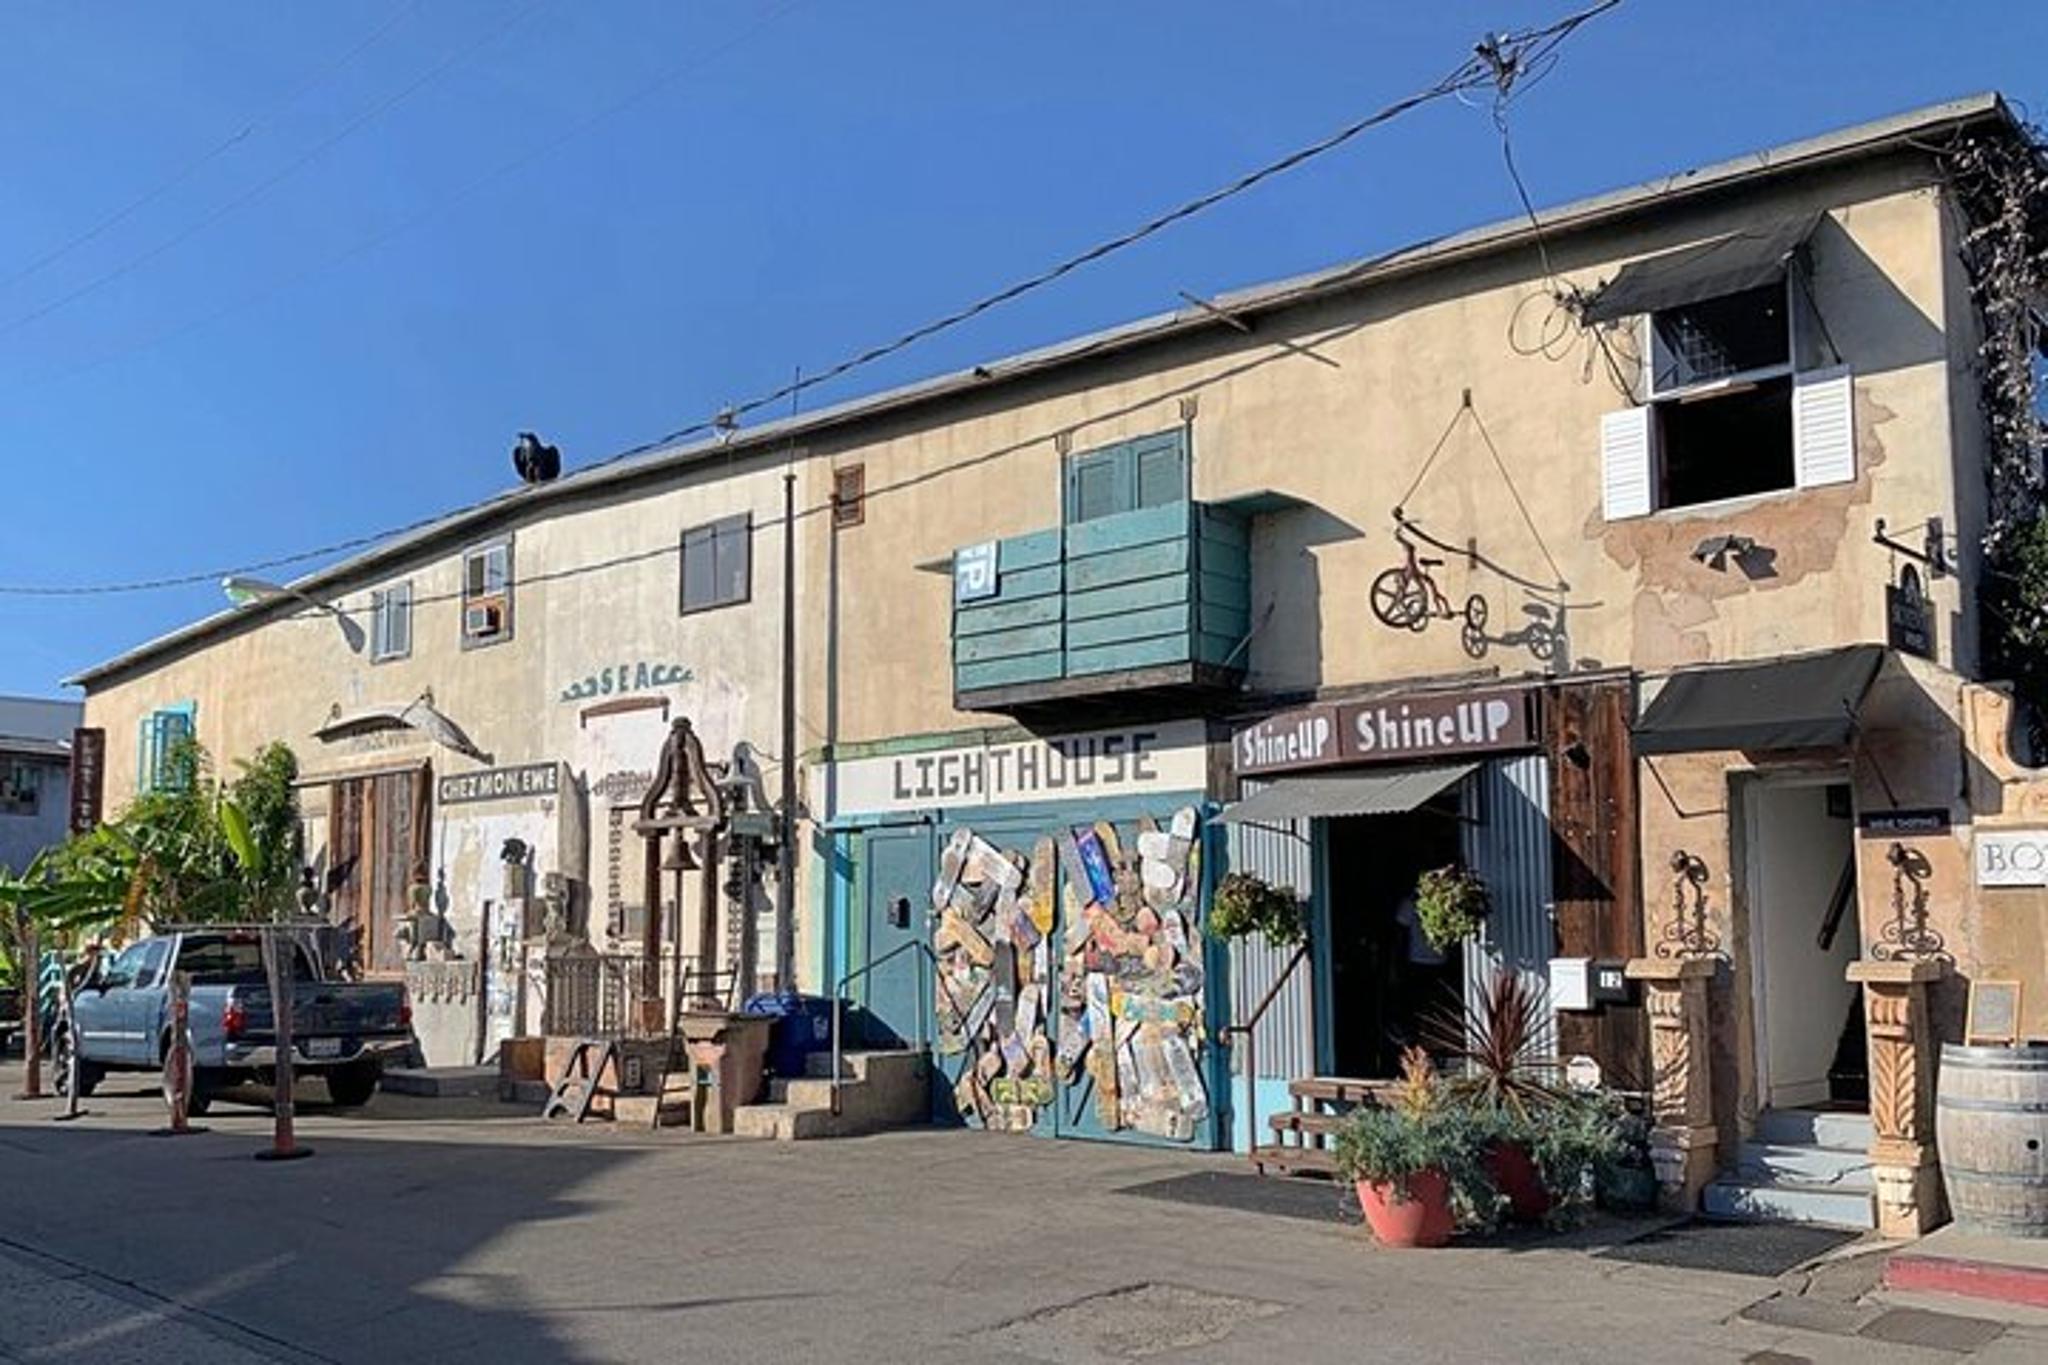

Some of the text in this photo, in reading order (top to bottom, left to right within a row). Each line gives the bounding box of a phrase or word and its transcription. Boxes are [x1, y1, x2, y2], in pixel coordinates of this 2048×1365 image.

[1243, 717, 1330, 767] ShineUP
[1357, 700, 1511, 752] ShineUP
[480, 772, 519, 796] MON
[893, 733, 1157, 800] LIGHTHOUSE
[1983, 841, 2048, 874] BO
